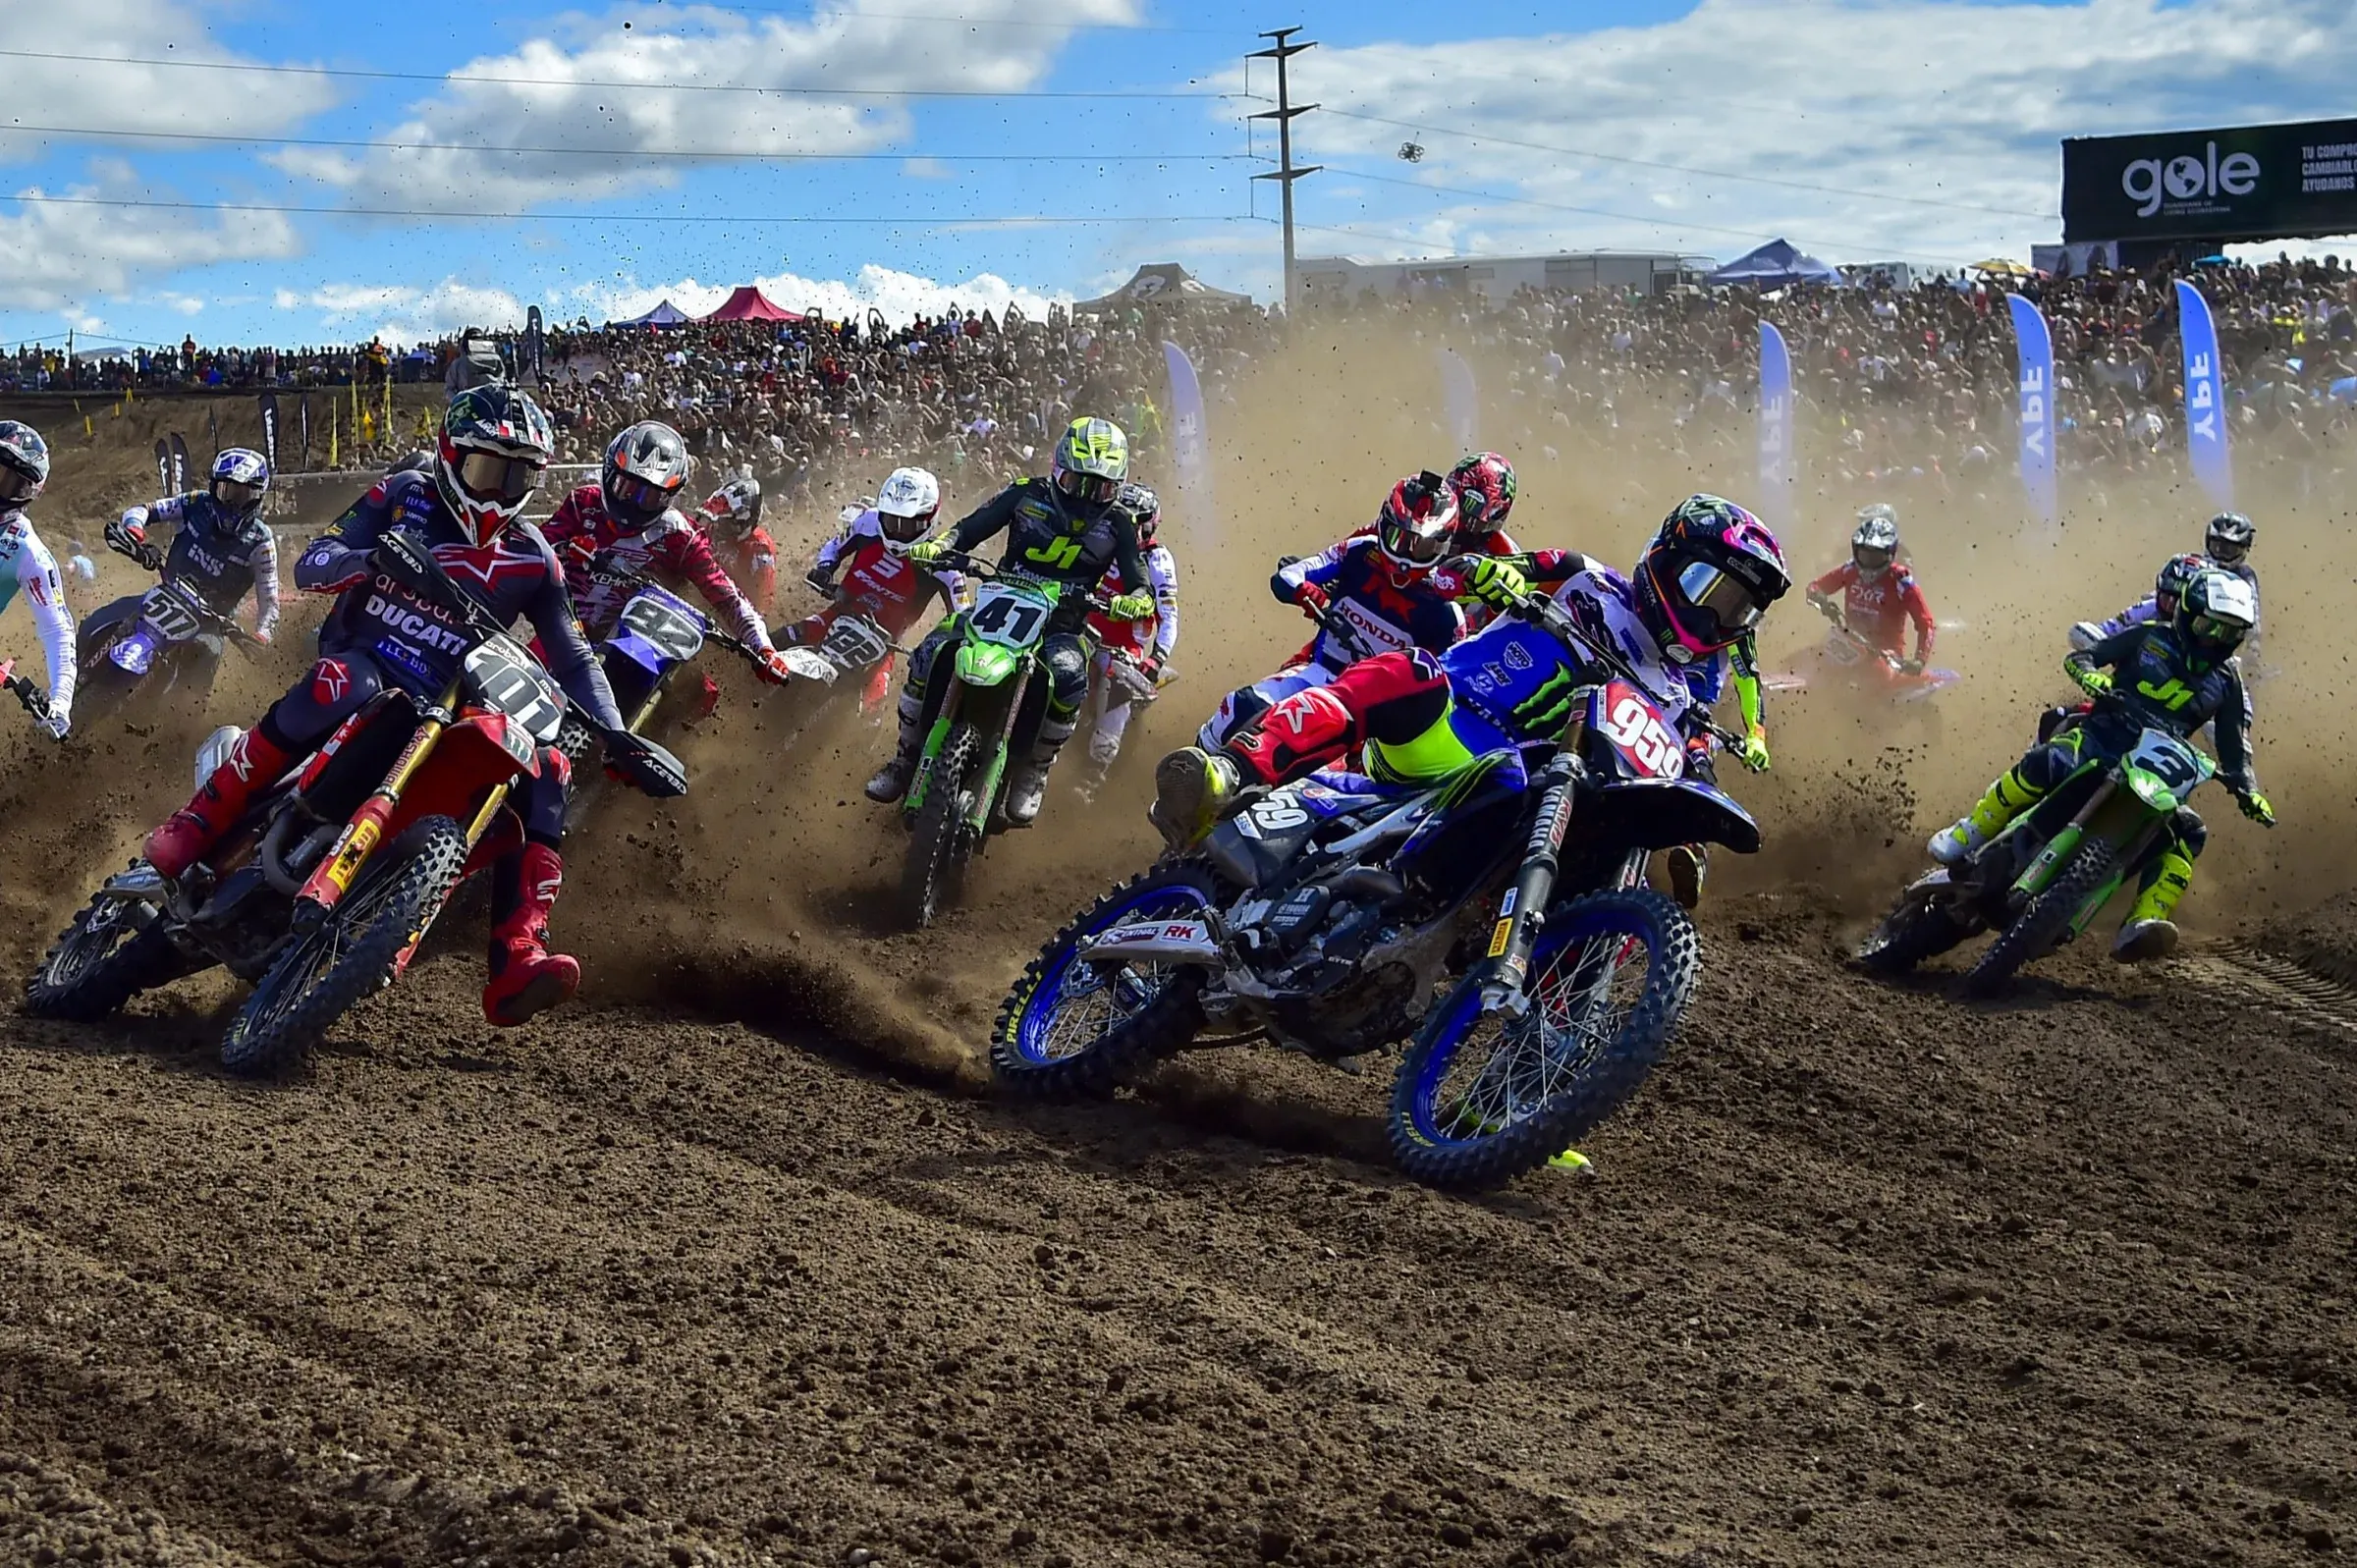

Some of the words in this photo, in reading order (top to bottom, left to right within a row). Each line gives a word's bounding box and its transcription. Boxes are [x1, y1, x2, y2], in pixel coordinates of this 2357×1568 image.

[145, 592, 193, 637] 517
[364, 594, 469, 656] DUCATI
[972, 597, 1043, 642] 41
[1339, 601, 1407, 650] HONDA
[475, 652, 561, 737] 101
[1252, 790, 1309, 831] 59
[1164, 925, 1197, 940] RK
[1006, 970, 1043, 1044] PIRELLI
